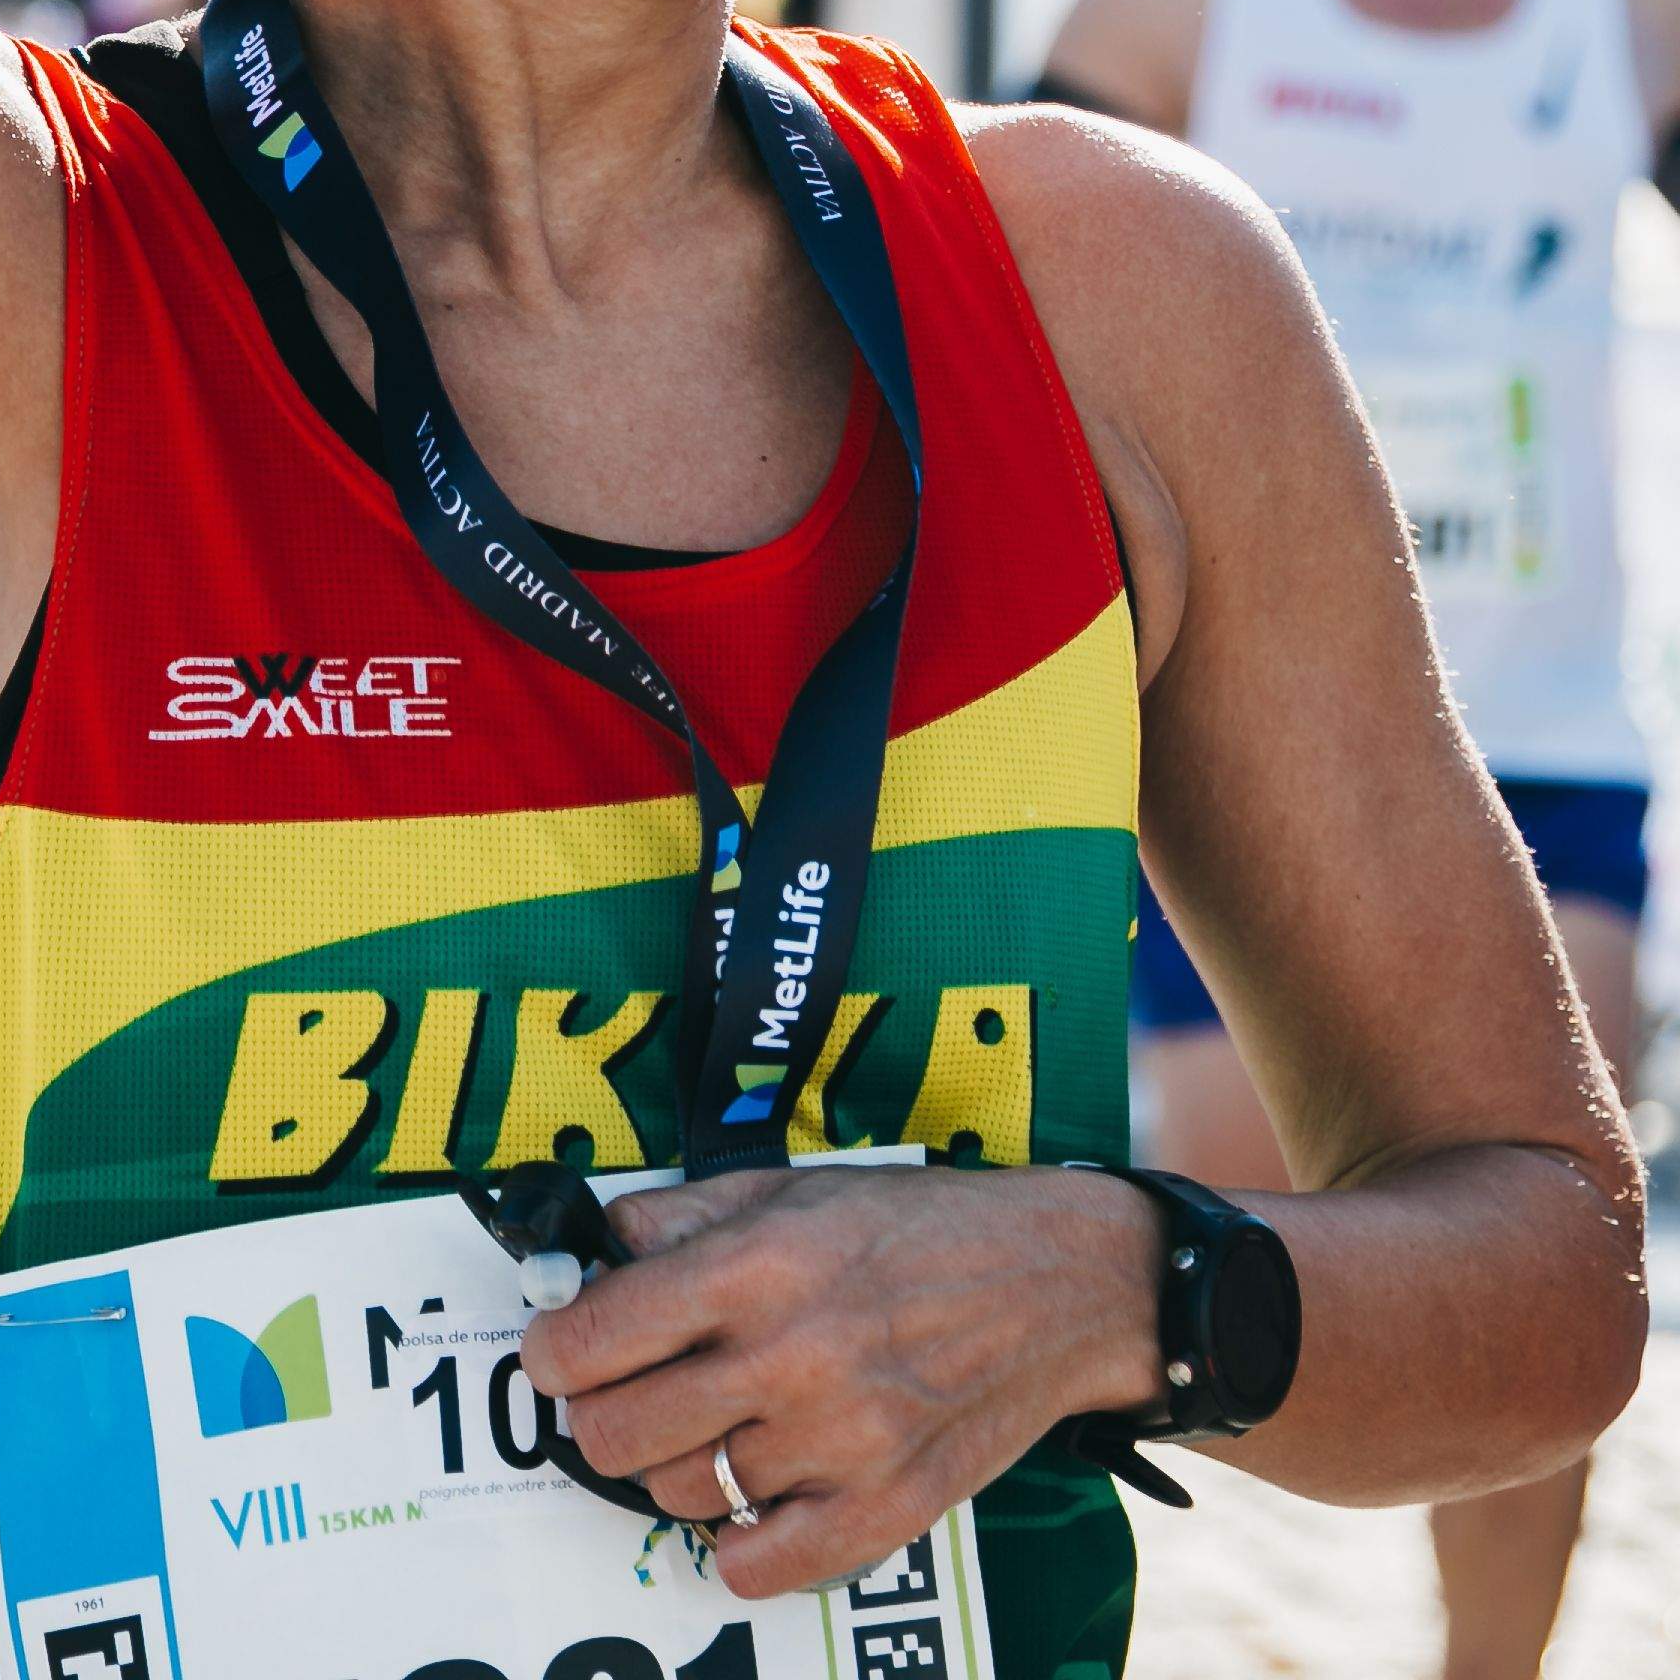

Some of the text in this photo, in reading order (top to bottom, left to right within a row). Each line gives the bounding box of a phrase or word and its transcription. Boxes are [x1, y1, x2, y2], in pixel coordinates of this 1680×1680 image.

[234, 23, 283, 128] MetLife
[779, 123, 844, 222] ACTIVA
[416, 410, 620, 657] MADRID ACTIVA
[166, 653, 462, 701] SWEET
[148, 694, 453, 741] SMILE
[752, 860, 831, 1050] MetLife
[208, 983, 1032, 1182] BIKLA
[400, 1331, 444, 1348] bolsa
[448, 1330, 469, 1343] de
[210, 1482, 308, 1551] VIII
[318, 1503, 395, 1534] 15KM
[419, 1484, 480, 1501] poignée
[485, 1481, 504, 1495] de
[507, 1479, 546, 1493] votre
[74, 1596, 106, 1614] 1961
